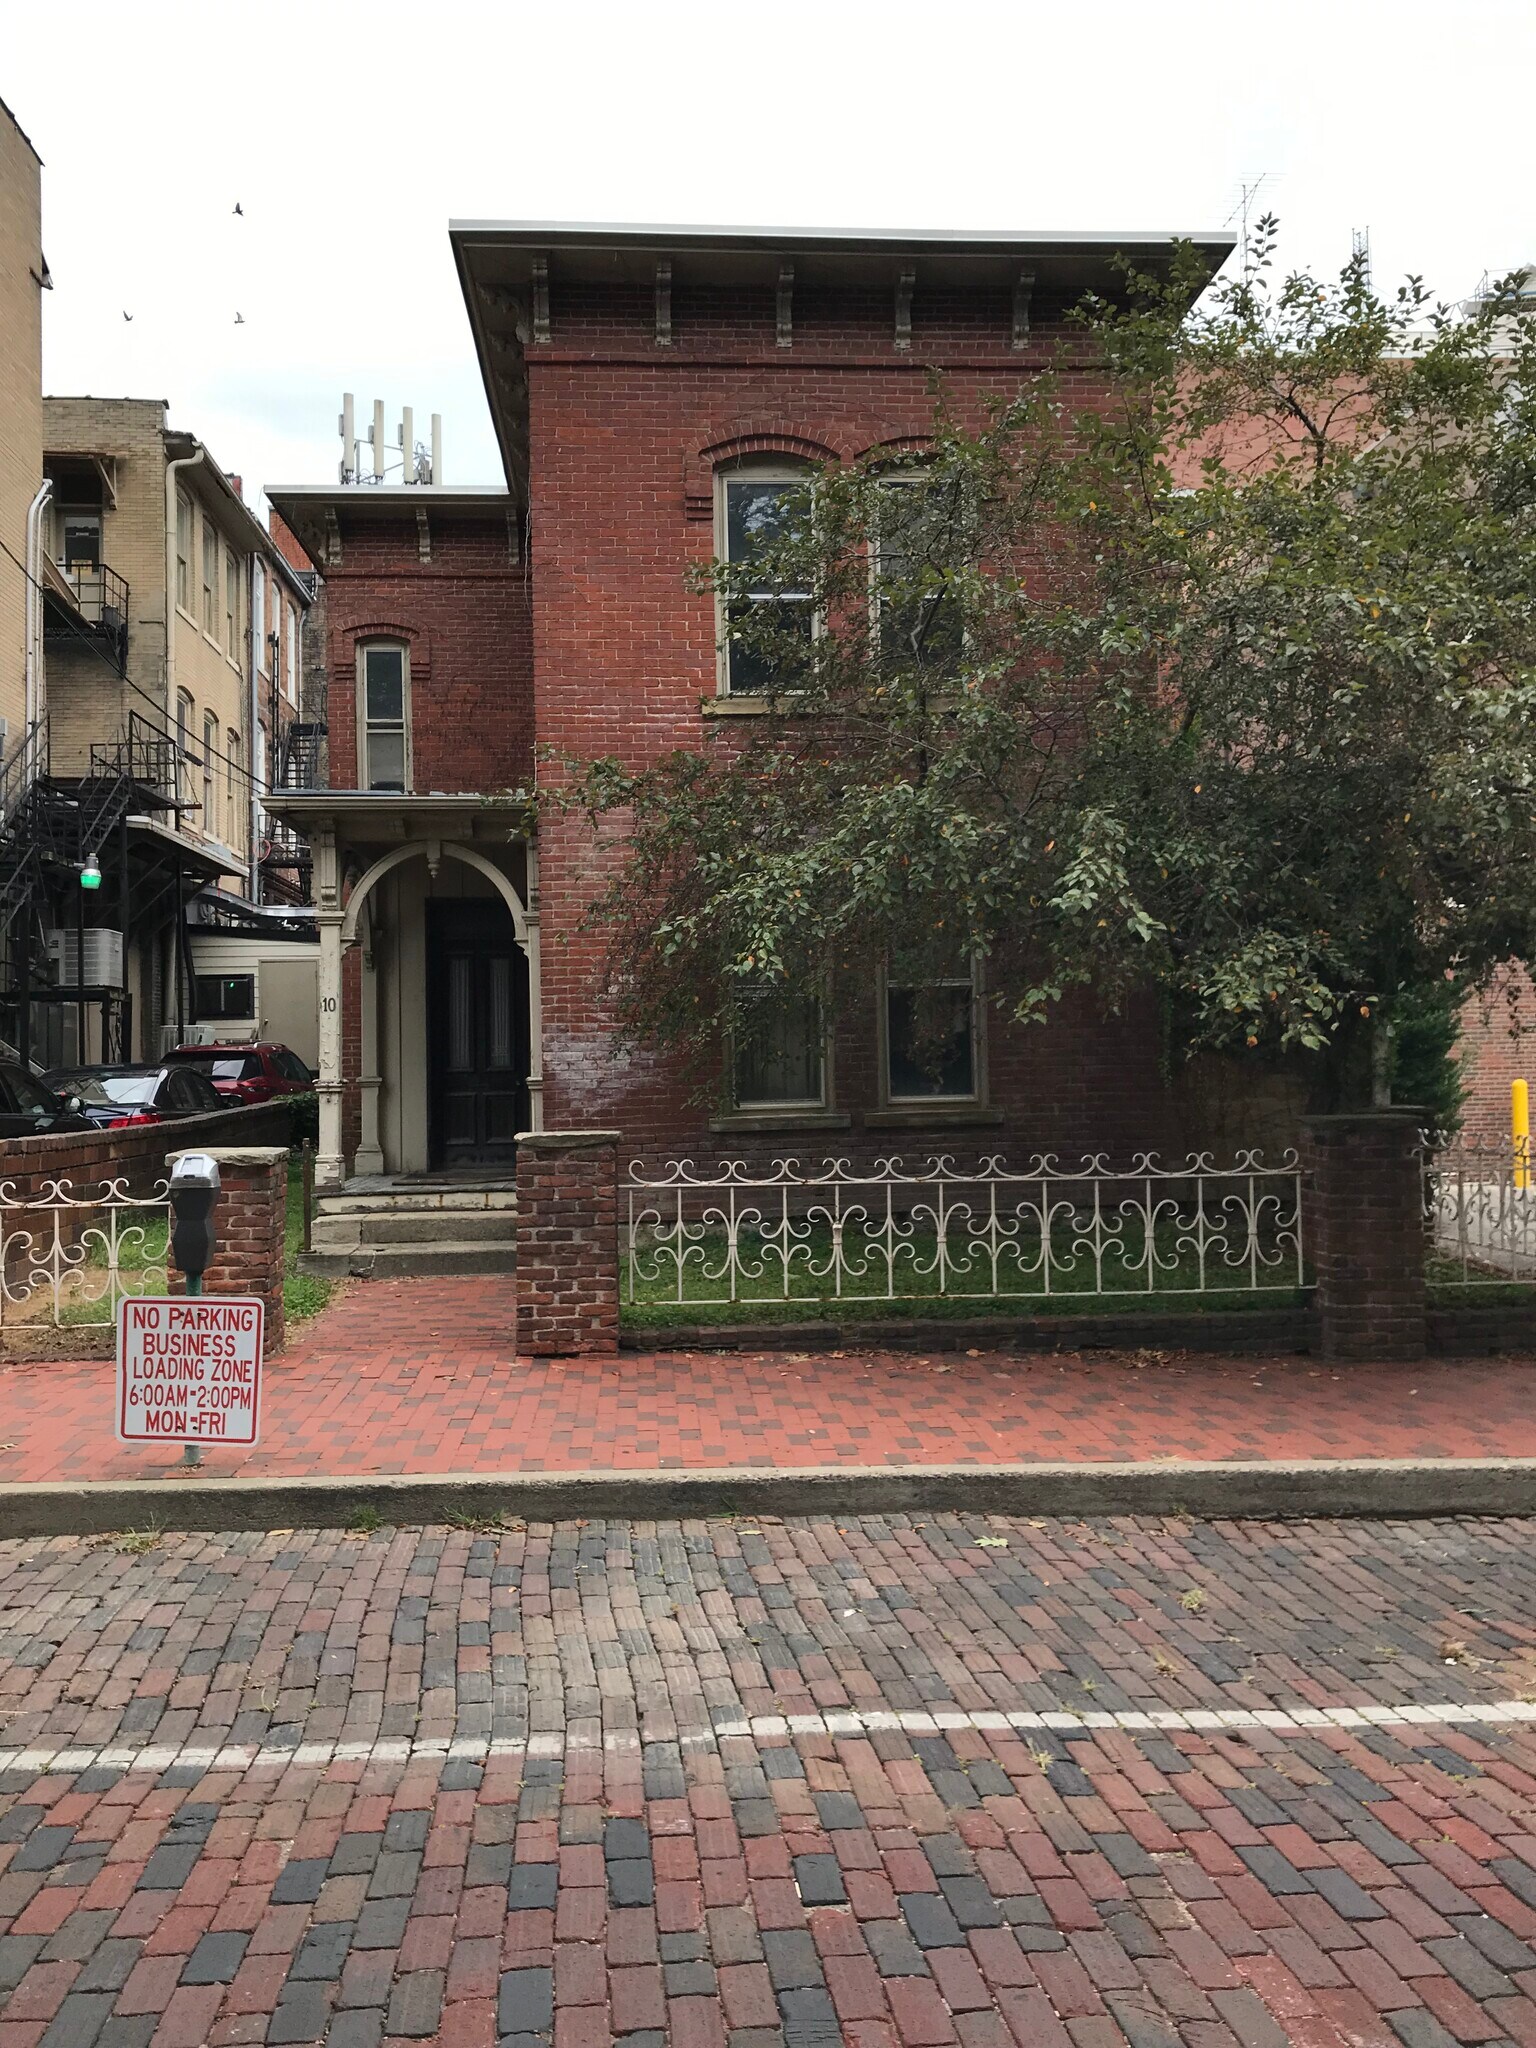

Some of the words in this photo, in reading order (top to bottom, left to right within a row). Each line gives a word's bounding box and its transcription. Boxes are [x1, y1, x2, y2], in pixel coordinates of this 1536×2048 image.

[322, 997, 336, 1012] 10
[133, 1306, 160, 1329] NO
[168, 1307, 253, 1332] PARKING
[143, 1333, 236, 1357] BUSINESS
[133, 1357, 205, 1380] LOADING
[211, 1359, 253, 1383] ZONE
